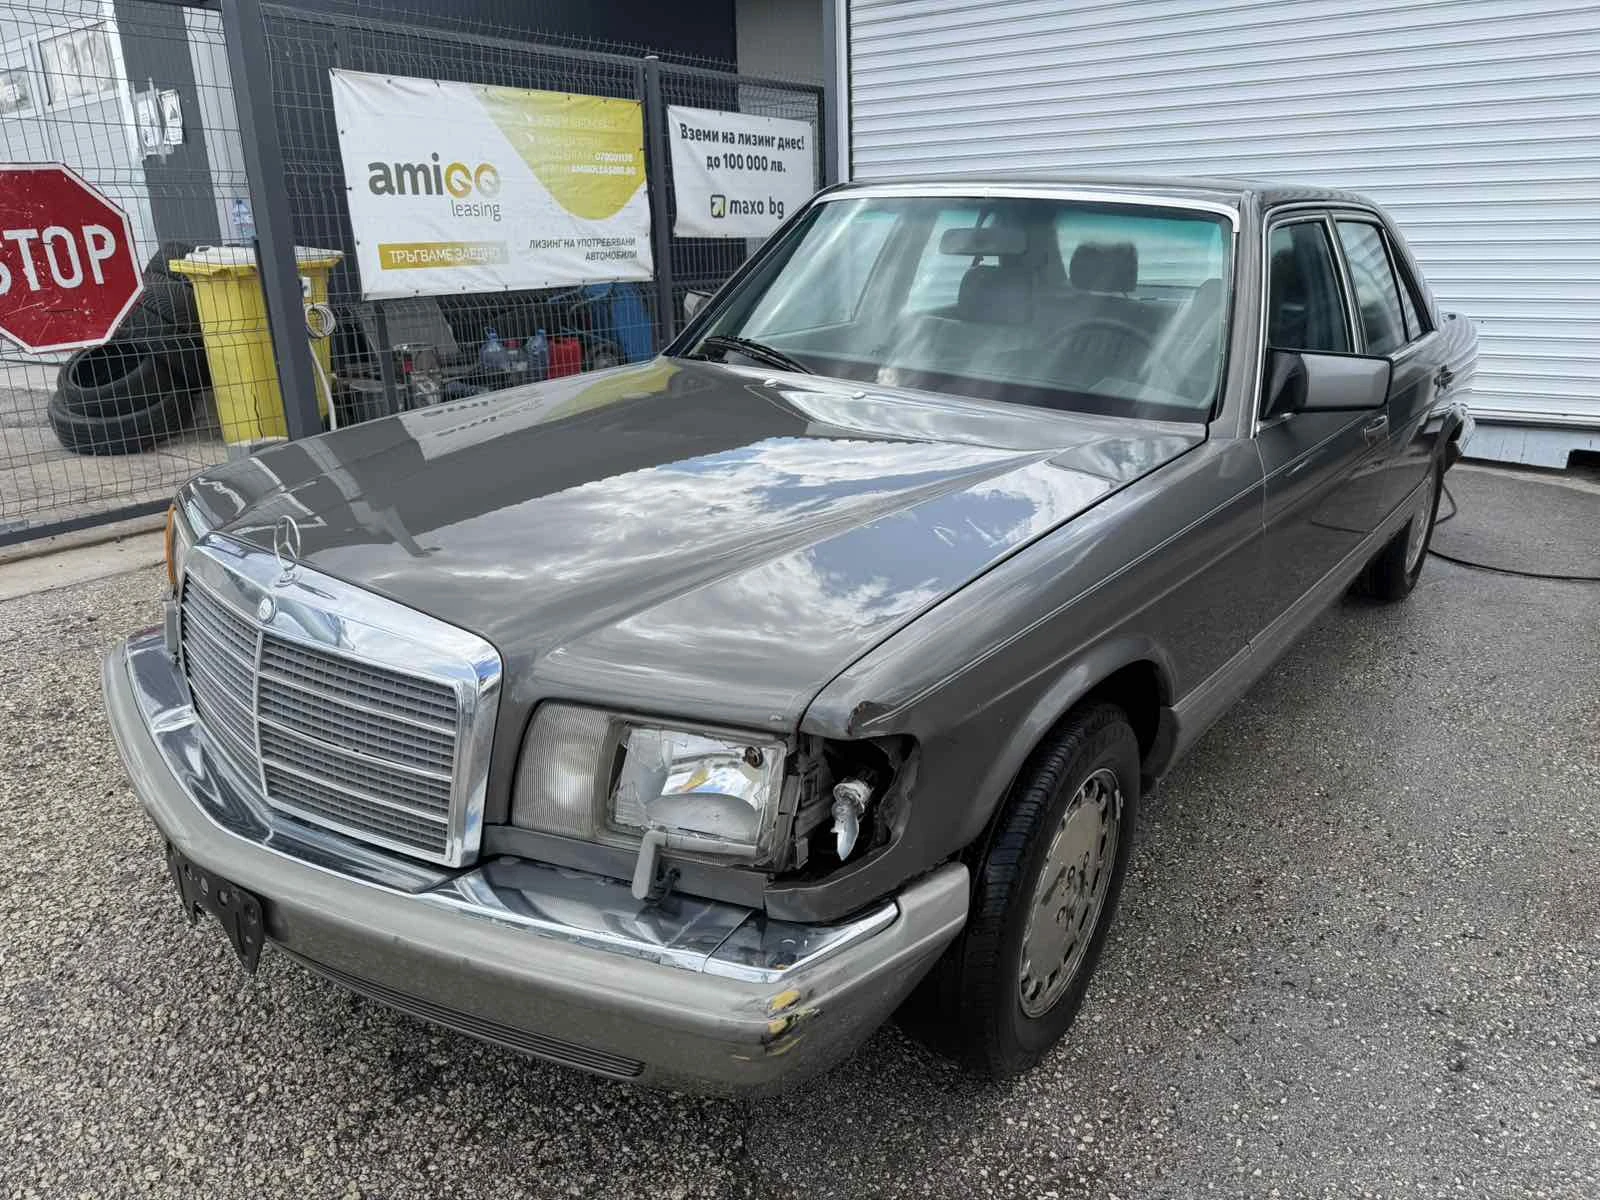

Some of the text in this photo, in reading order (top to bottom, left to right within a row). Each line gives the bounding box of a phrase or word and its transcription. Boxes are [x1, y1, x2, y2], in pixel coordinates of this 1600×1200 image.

[679, 122, 805, 151] Вземи на лизинг днес!
[706, 152, 786, 173] до 100 000 лв.
[450, 200, 502, 222] leasing
[529, 239, 562, 249] ЛИЗИНГ
[564, 239, 576, 249] НА
[388, 247, 454, 265] ТРЪГВАМЕ
[585, 250, 638, 261] АВТОМОБИЛИ
